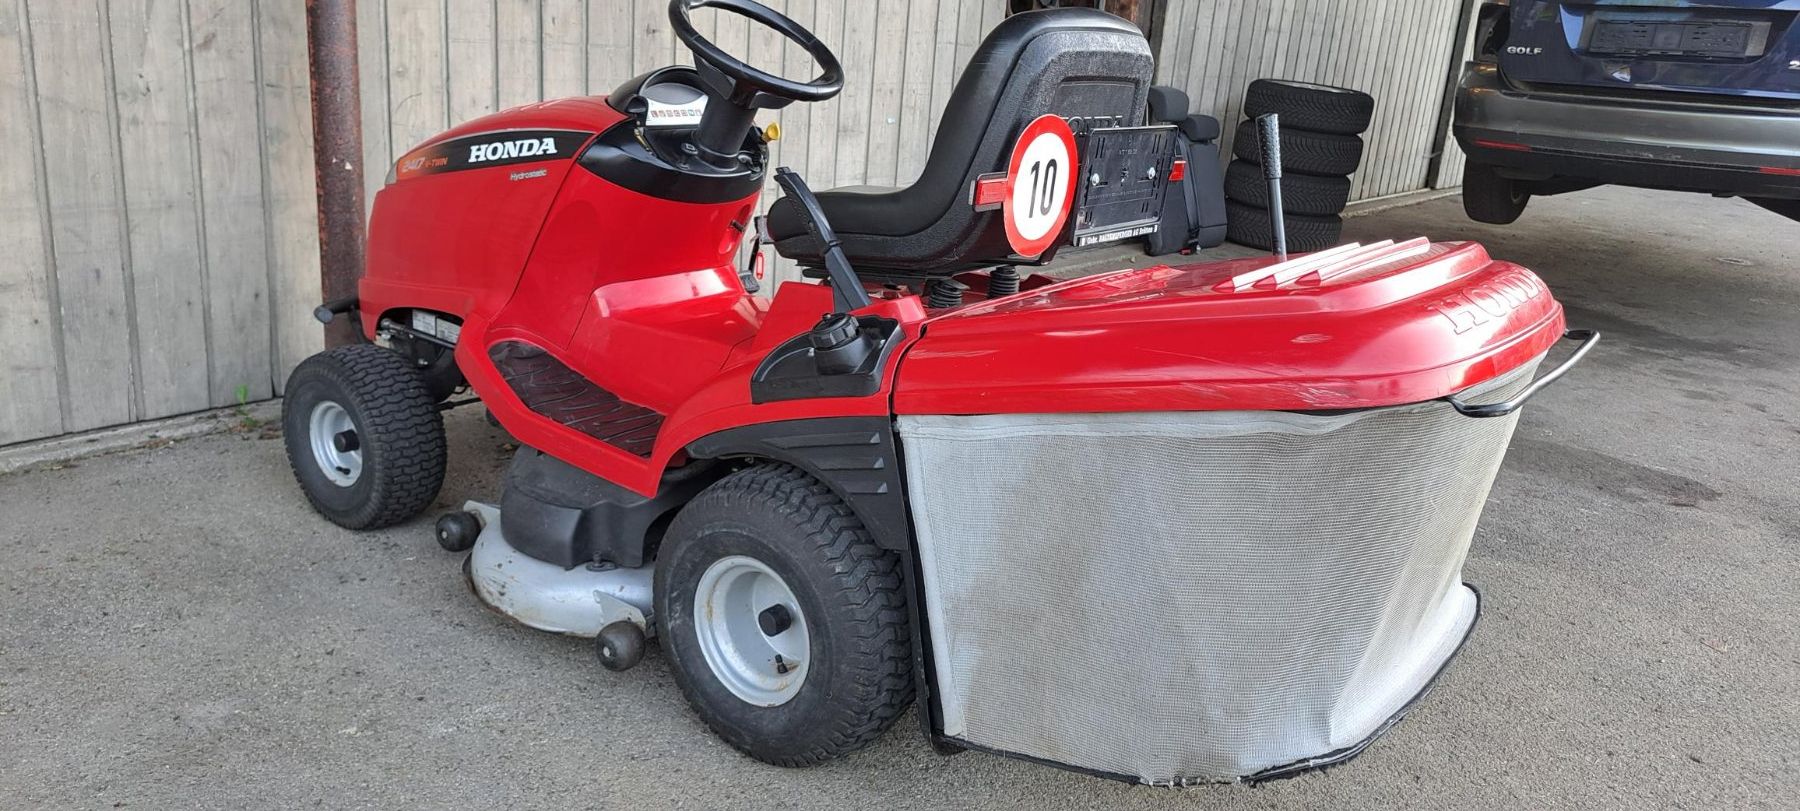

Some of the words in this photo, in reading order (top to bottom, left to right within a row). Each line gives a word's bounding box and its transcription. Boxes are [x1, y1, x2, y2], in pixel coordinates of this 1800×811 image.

[1506, 46, 1542, 55] GOLF
[468, 137, 558, 163] HONDA
[1028, 158, 1058, 219] 10
